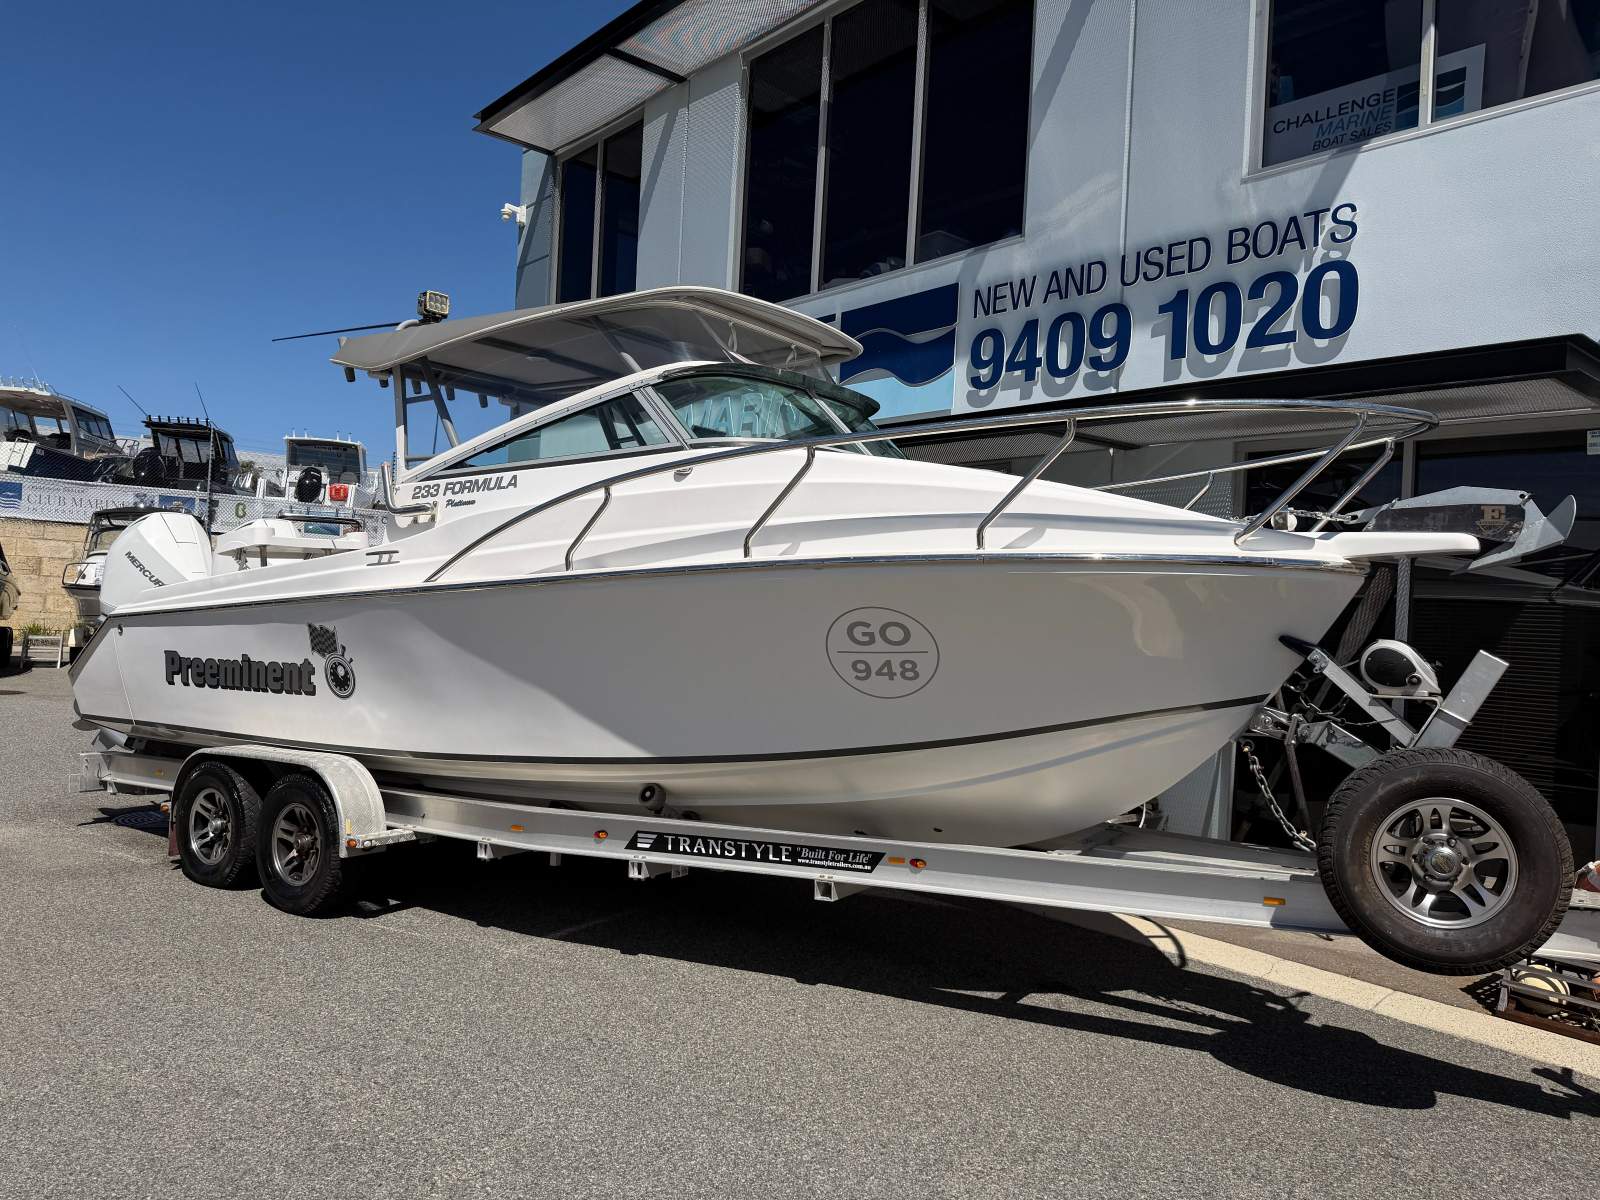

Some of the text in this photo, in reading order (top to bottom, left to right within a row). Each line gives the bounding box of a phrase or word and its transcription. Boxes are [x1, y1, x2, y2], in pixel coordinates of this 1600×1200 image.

[1273, 88, 1396, 133] CHALLENGE
[1315, 104, 1392, 138] MARINE
[1312, 121, 1392, 151] BOAT SALES
[973, 202, 1358, 318] NEW AND USED BOATS
[970, 259, 1360, 390] 9409 1020
[412, 475, 518, 499] 233 FORMULA
[846, 621, 911, 646] GO
[164, 650, 316, 696] Preeminent
[851, 659, 920, 681] 948
[664, 835, 792, 862] TRANSTYLE
[828, 850, 847, 861] For
